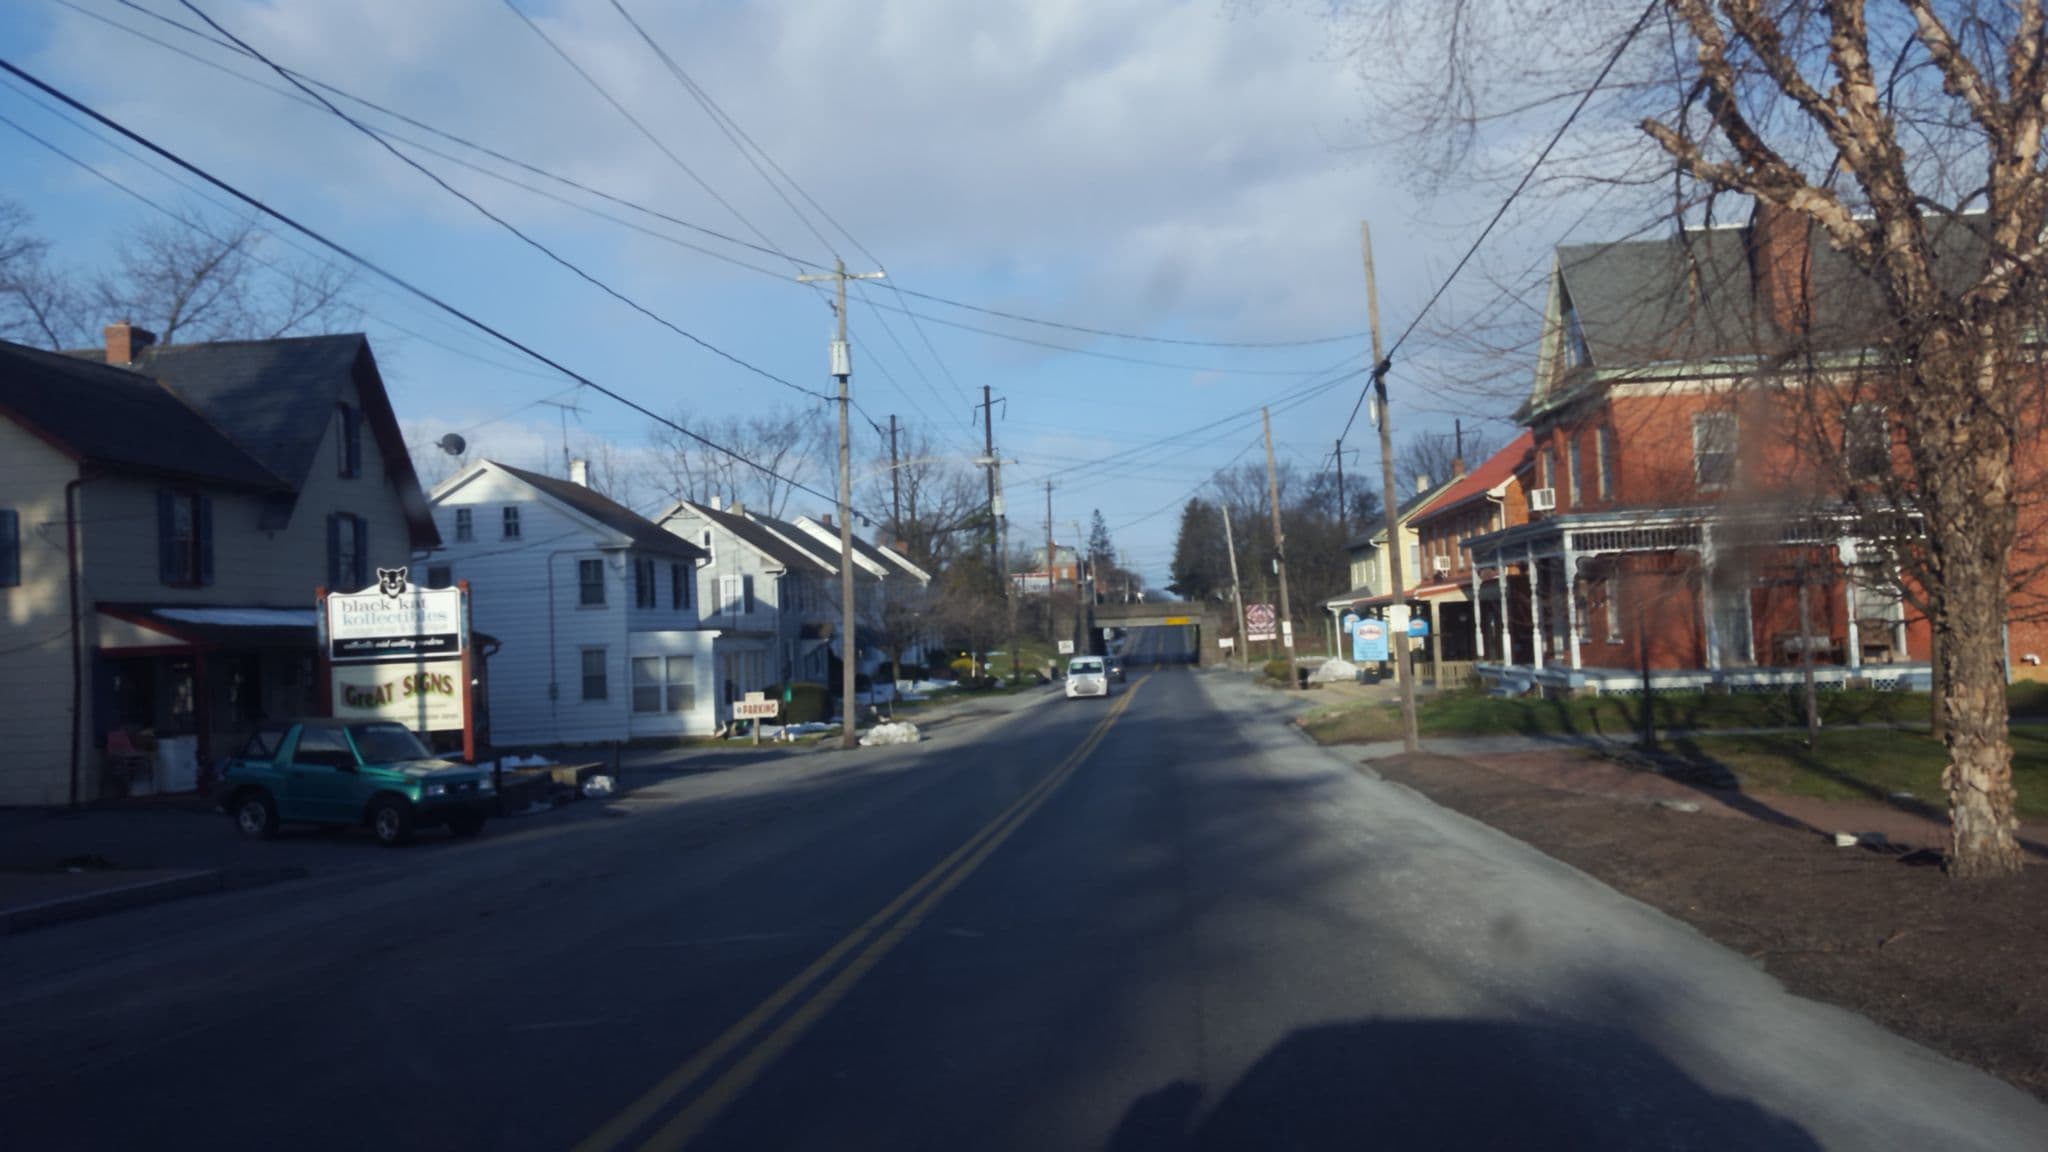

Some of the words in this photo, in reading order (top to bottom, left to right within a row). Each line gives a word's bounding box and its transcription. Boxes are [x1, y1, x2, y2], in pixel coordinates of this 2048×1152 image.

[342, 599, 391, 613] black
[399, 598, 427, 610] kat
[402, 672, 454, 697] SIGNS
[743, 704, 776, 714] PARKING
